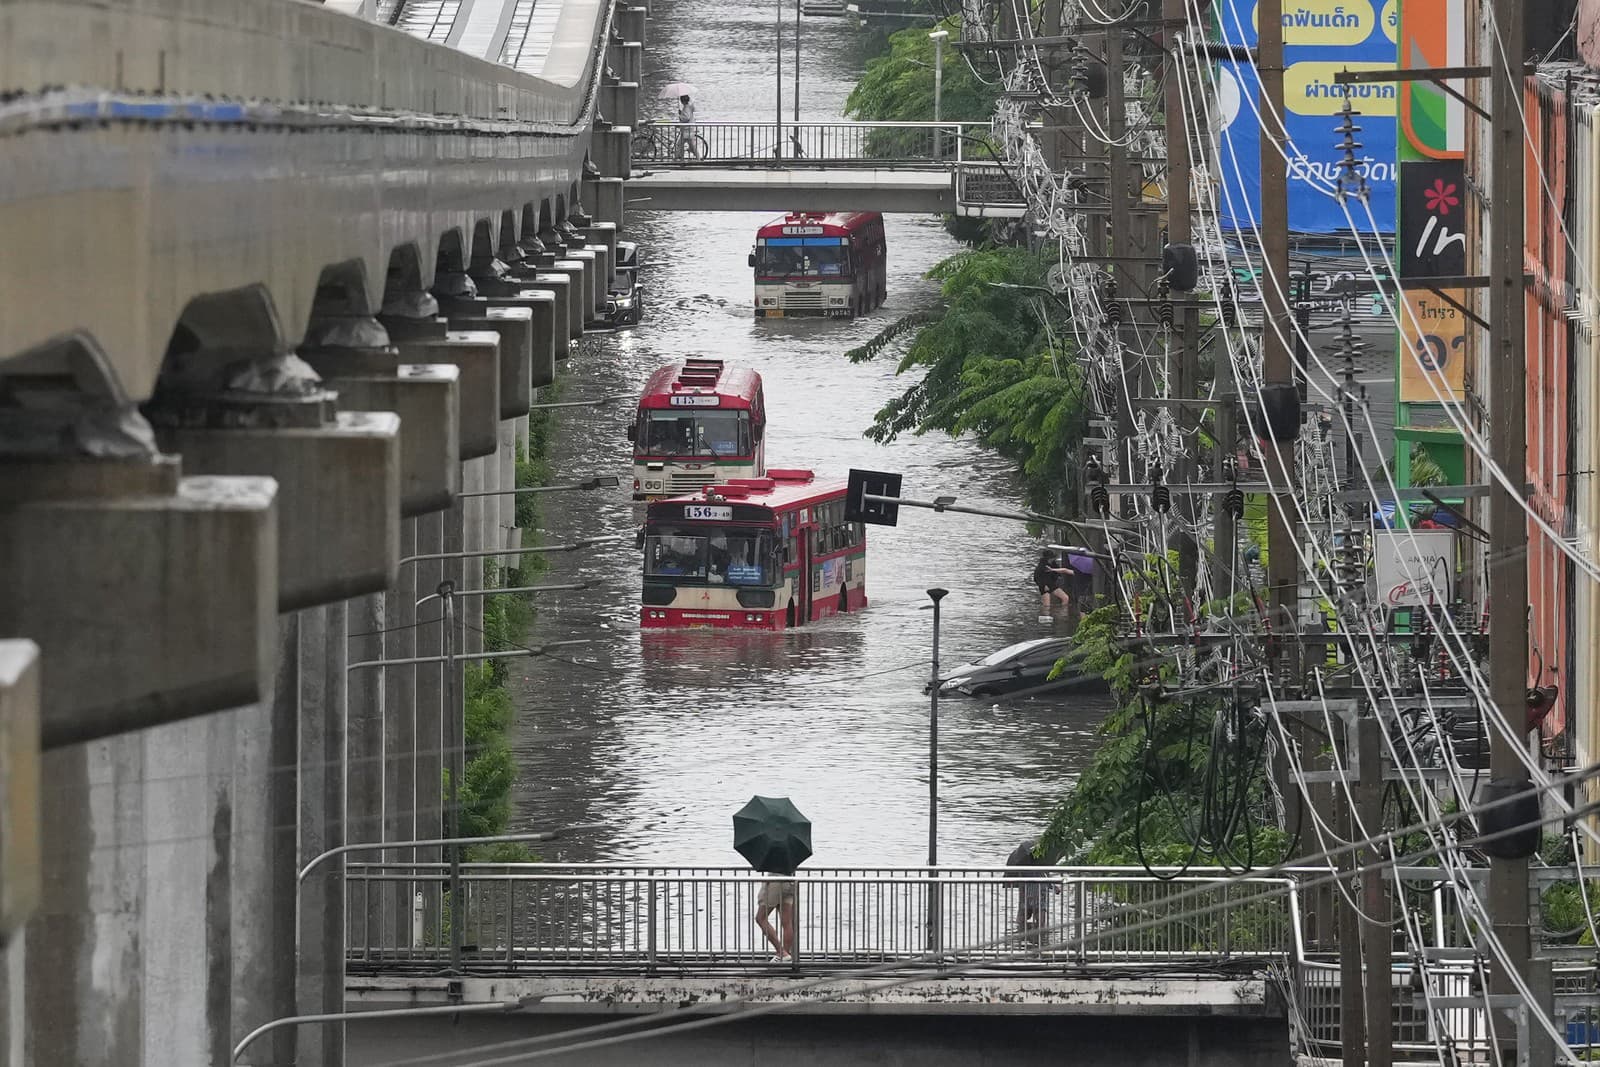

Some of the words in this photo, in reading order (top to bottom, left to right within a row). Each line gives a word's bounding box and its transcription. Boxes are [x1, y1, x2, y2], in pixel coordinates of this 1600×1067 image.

[1281, 7, 1359, 28] ดฟันเด็ก
[685, 506, 712, 518] 156
